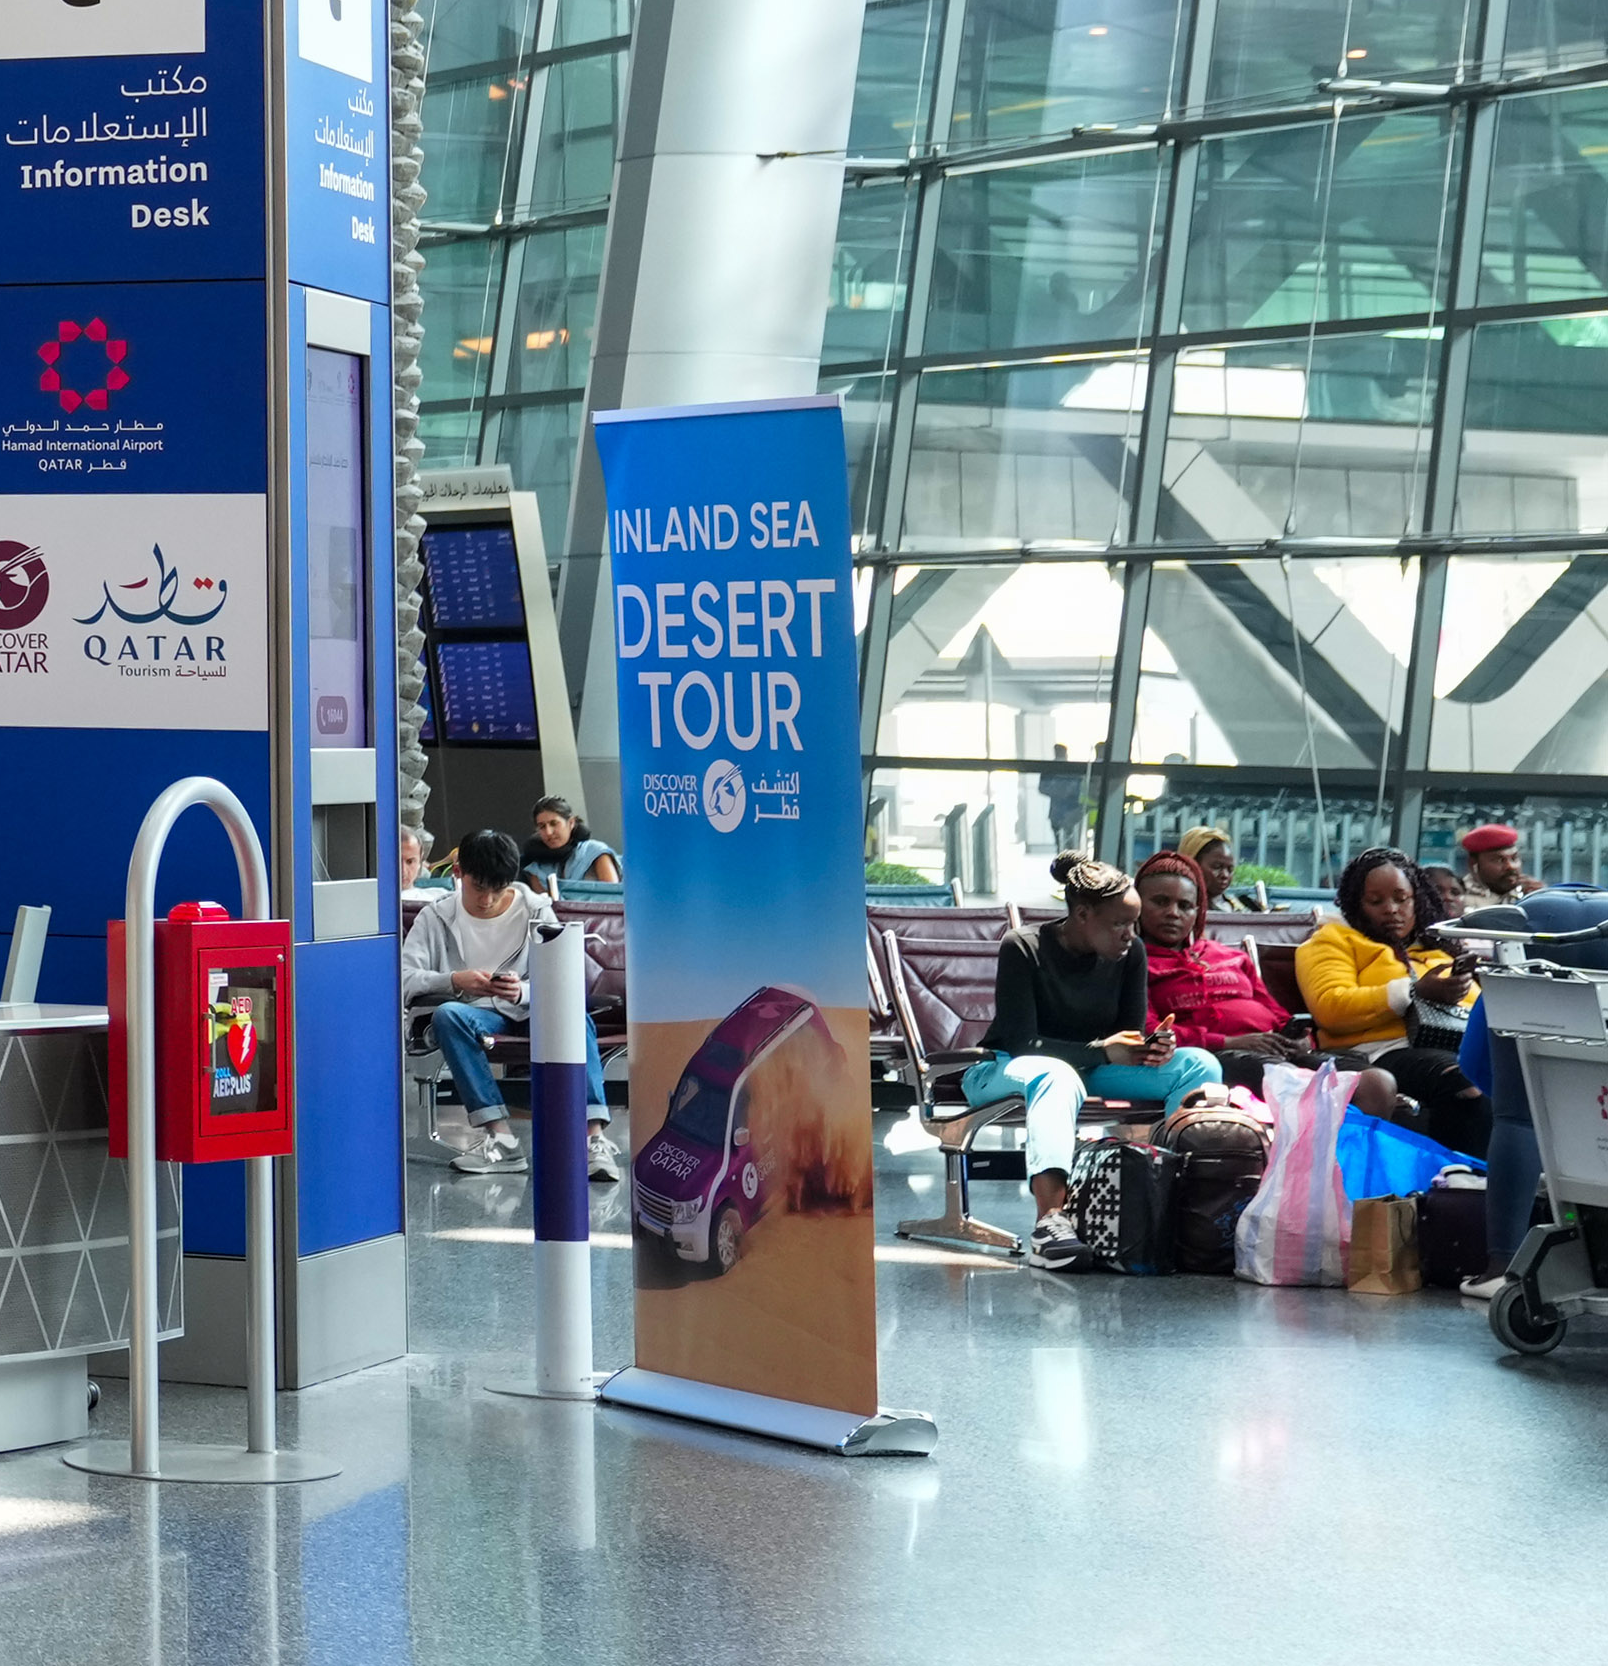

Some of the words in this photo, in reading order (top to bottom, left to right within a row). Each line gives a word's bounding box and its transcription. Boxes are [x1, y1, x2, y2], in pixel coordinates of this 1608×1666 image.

[120, 65, 207, 103] مكتب
[347, 88, 373, 117] مكتب
[5, 106, 208, 148] الإستعلامات
[20, 155, 208, 189] Information
[319, 163, 374, 202] Information
[131, 198, 209, 228] Desk
[351, 216, 375, 244] Desk
[2, 419, 59, 437] الدولي
[65, 422, 110, 432] حمد
[114, 419, 164, 434] مطار
[2, 440, 43, 451] Hamad
[46, 439, 120, 451] International
[122, 439, 164, 453] Airport
[38, 458, 83, 472] QATAR
[87, 458, 127, 473] قطر
[614, 504, 740, 554] INLAND
[750, 500, 820, 550] SEA
[617, 578, 836, 659] DESERT
[83, 634, 226, 666] QATAR
[118, 665, 171, 678] Tourism
[175, 665, 227, 681] للسياحة
[638, 670, 804, 752] TOUR
[643, 774, 698, 792] DISCOVER
[644, 791, 699, 817] QATAR
[753, 796, 800, 824] قطر
[231, 996, 253, 1015] AED
[649, 1151, 692, 1180] QATAR
[657, 1141, 701, 1169] DISCOVER
